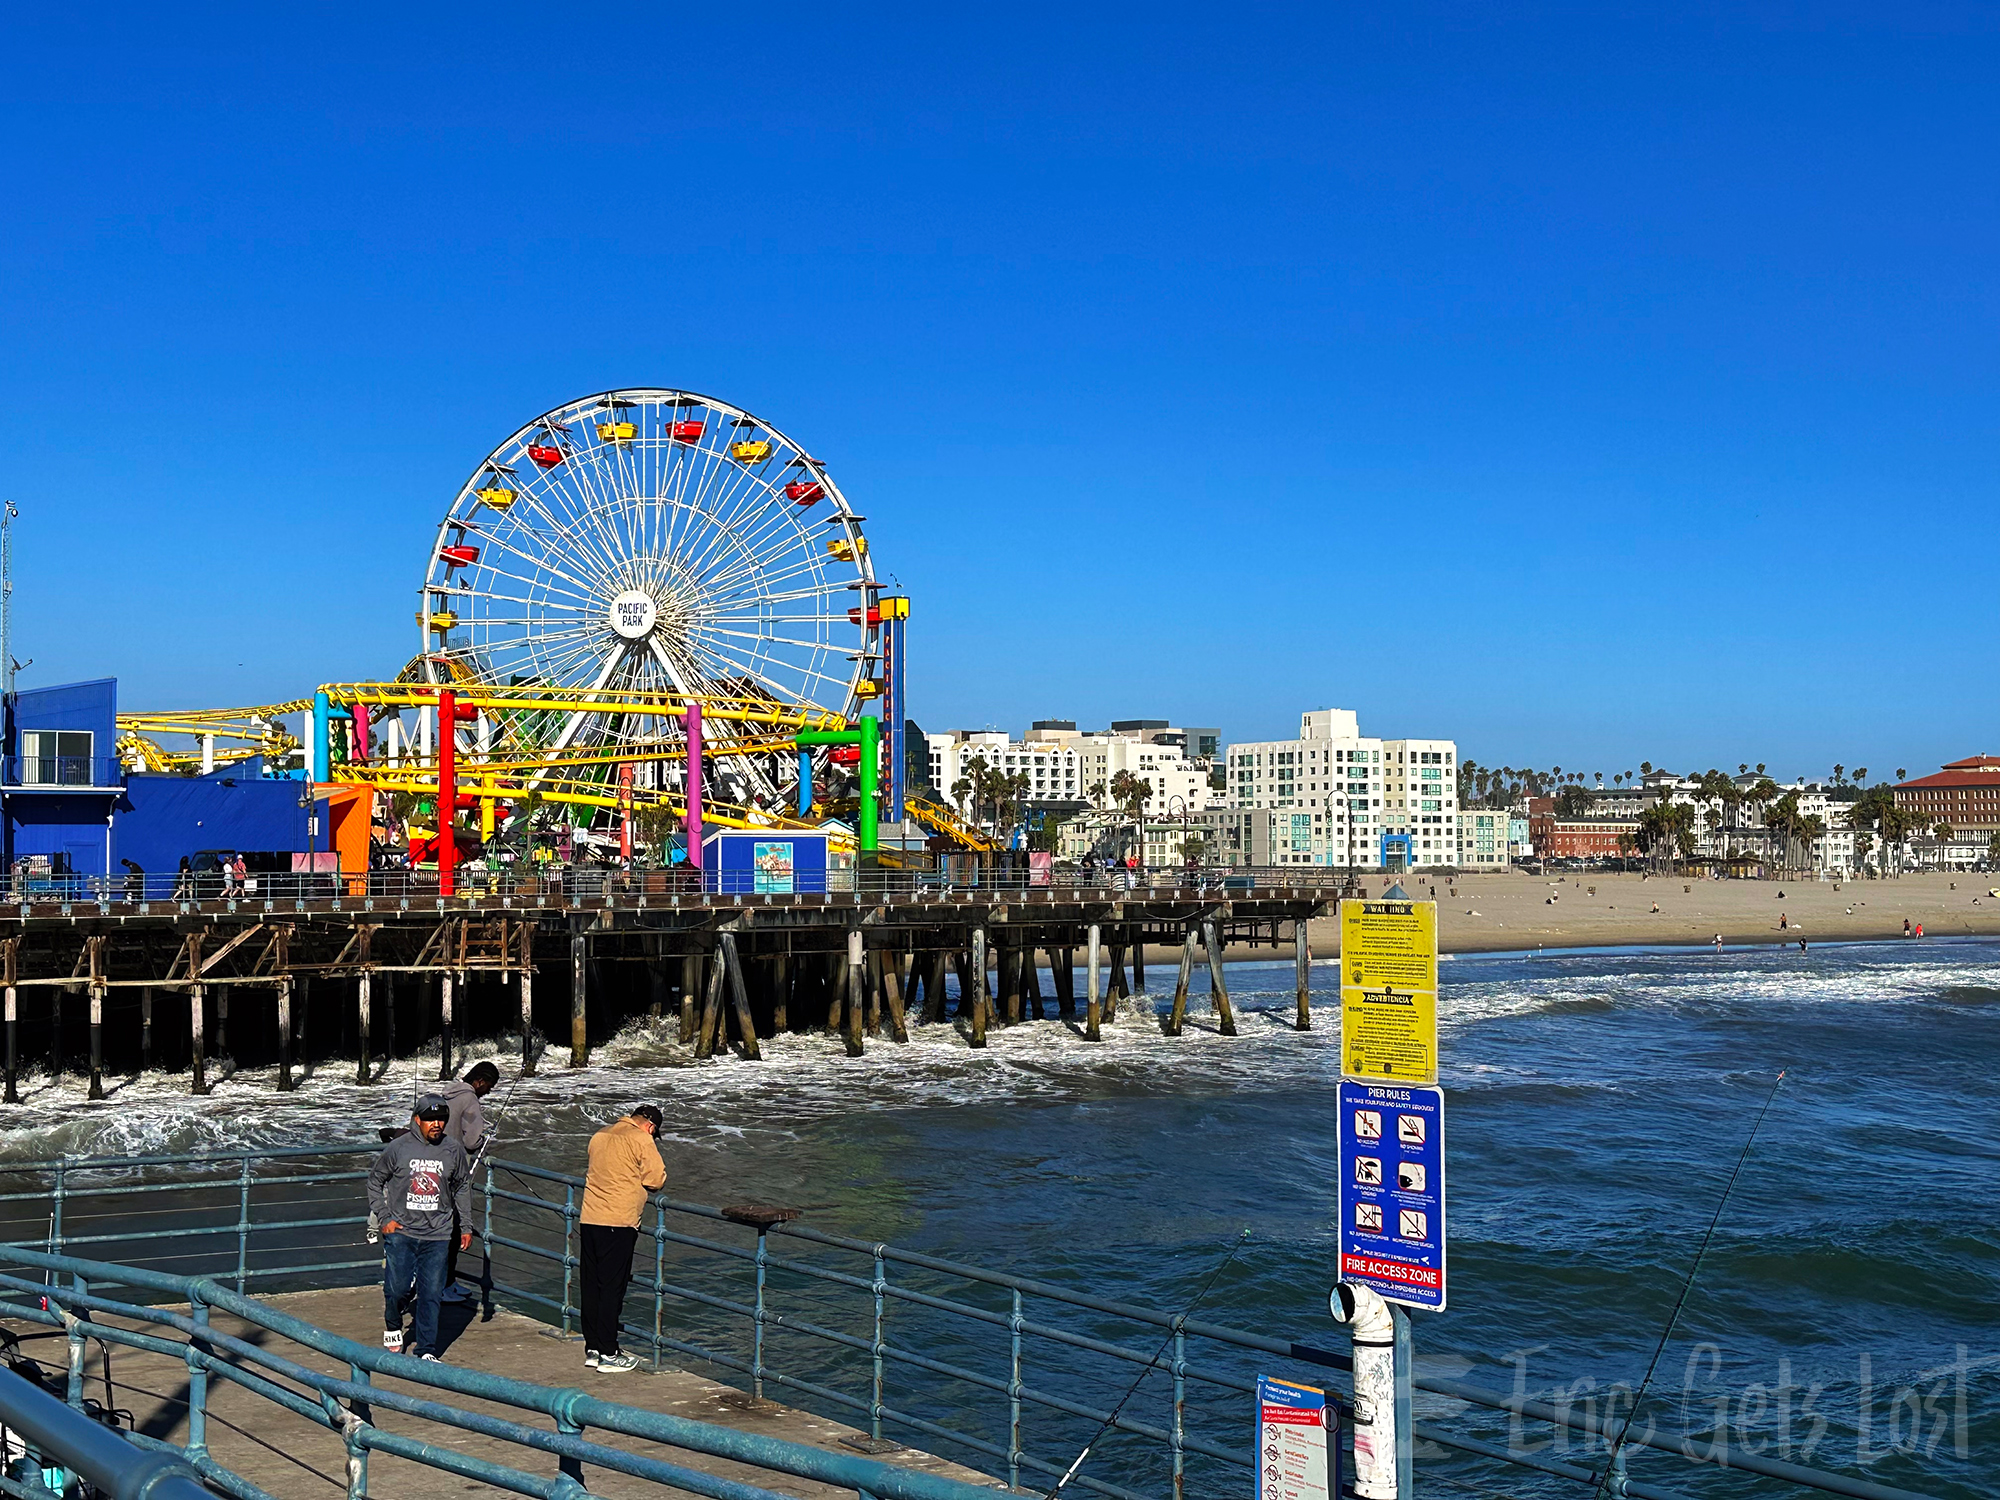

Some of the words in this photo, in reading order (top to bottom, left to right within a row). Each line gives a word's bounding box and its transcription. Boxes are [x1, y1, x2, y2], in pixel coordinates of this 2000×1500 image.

[618, 602, 648, 614] PACIFIC
[622, 616, 643, 626] PARK
[1368, 1088, 1386, 1098] PIER
[1386, 1089, 1411, 1101] RULES
[409, 1159, 444, 1170] GRANDPA
[407, 1192, 440, 1203] FISHING
[1346, 1258, 1366, 1272] FIRE
[1368, 1262, 1408, 1279] ACCESS
[1409, 1269, 1437, 1284] ZONE
